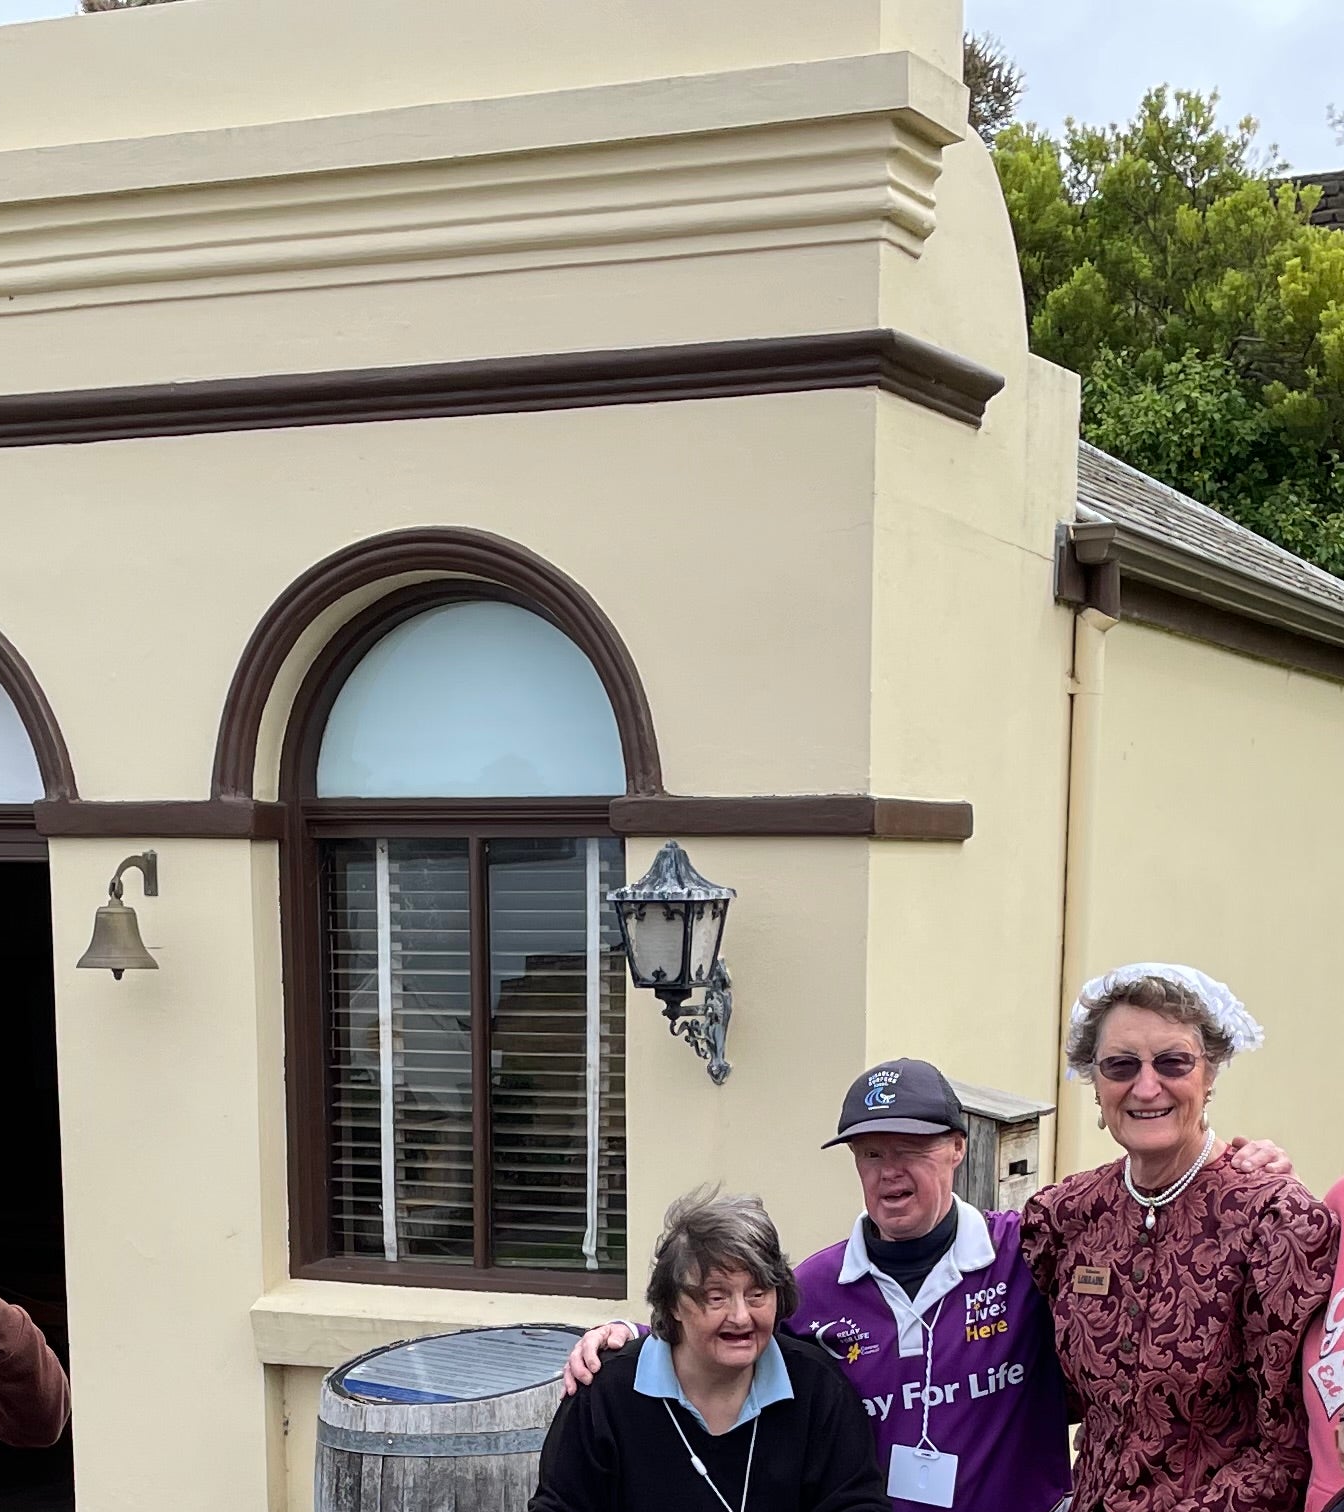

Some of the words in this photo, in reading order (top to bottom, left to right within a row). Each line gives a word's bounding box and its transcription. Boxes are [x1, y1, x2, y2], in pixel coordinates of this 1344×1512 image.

[965, 1281, 1008, 1310] Hope
[965, 1300, 1008, 1326] Lives
[965, 1319, 1009, 1343] Here
[902, 1381, 960, 1410] For
[968, 1361, 1025, 1399] Life
